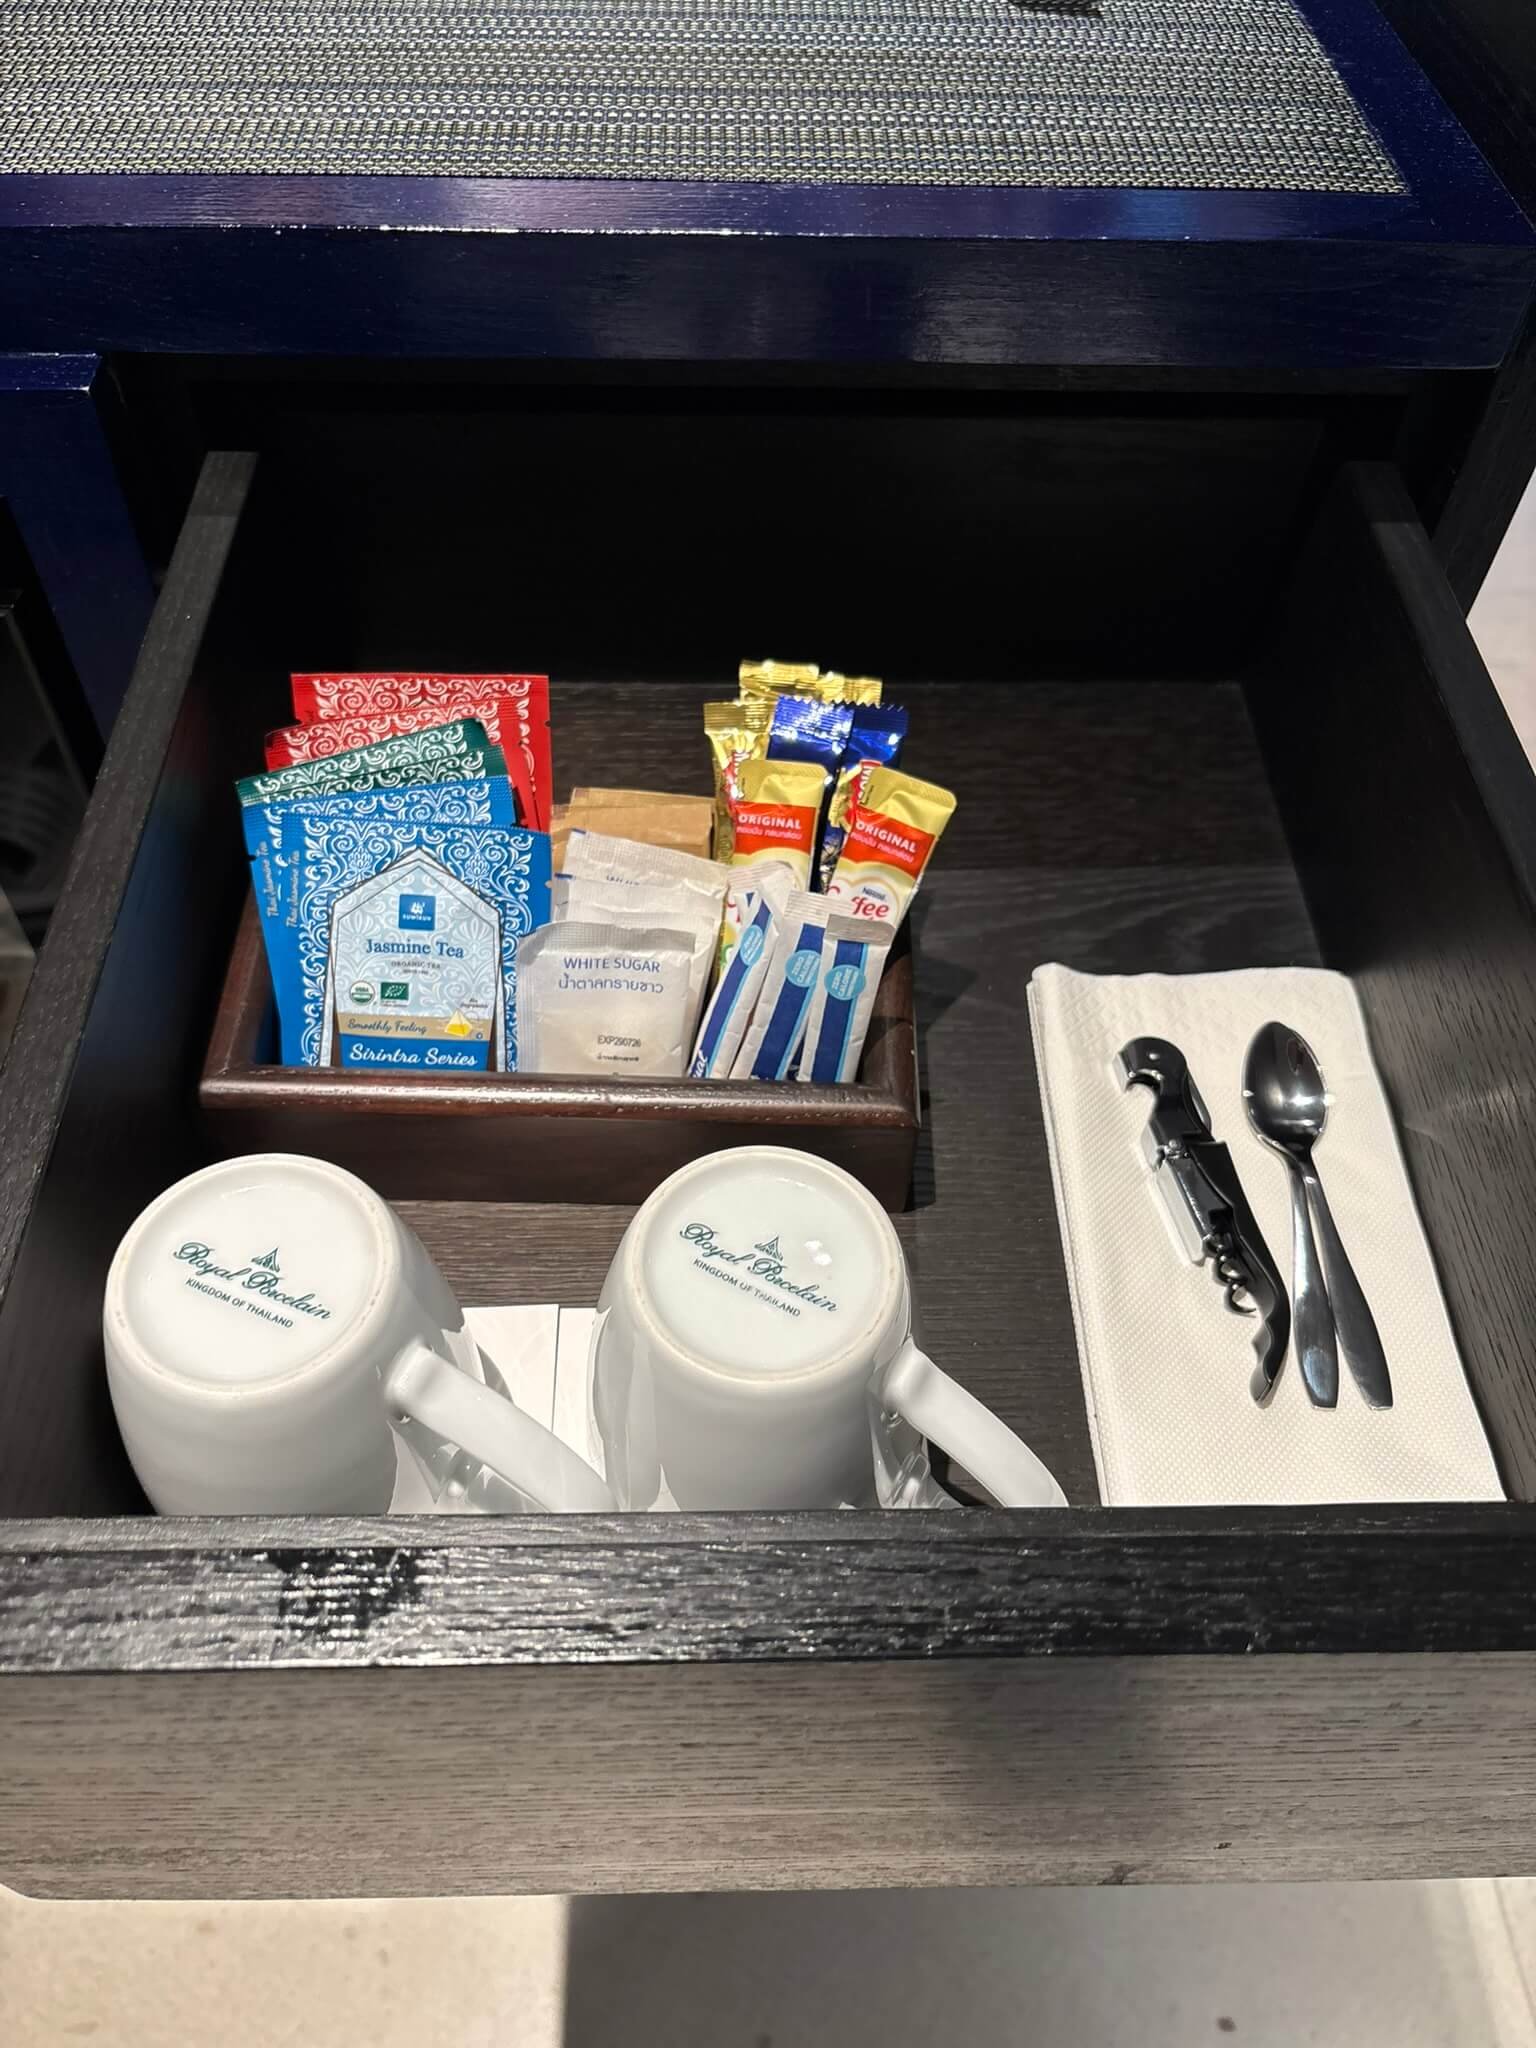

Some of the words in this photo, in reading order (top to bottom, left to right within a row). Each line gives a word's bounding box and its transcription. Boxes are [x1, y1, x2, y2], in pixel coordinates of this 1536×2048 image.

[737, 813, 802, 829] ORIGINAL
[855, 820, 917, 853] ORIGINAL
[366, 939, 431, 954] Jasmine
[436, 941, 464, 958] Tea
[391, 960, 425, 968] ORGANIC
[564, 957, 610, 969] WHITE
[614, 957, 660, 973] SUGAR
[558, 972, 664, 994] น้ำตาลทรายขาว
[347, 1018, 392, 1033] Smoothly
[395, 1020, 427, 1033] Feeling
[350, 1042, 421, 1064] Sirintra
[424, 1048, 478, 1066] Series
[679, 1223, 756, 1265] Royal
[747, 1257, 838, 1313] Porcelain
[173, 1242, 251, 1281] Royal
[242, 1271, 331, 1320] Porcelain
[693, 1258, 738, 1287] KINGDOM
[739, 1281, 752, 1292] OF
[753, 1287, 801, 1317] THAILAND
[185, 1277, 231, 1302] KINGDOM
[232, 1297, 245, 1308] OF
[246, 1303, 294, 1329] THAILAND
